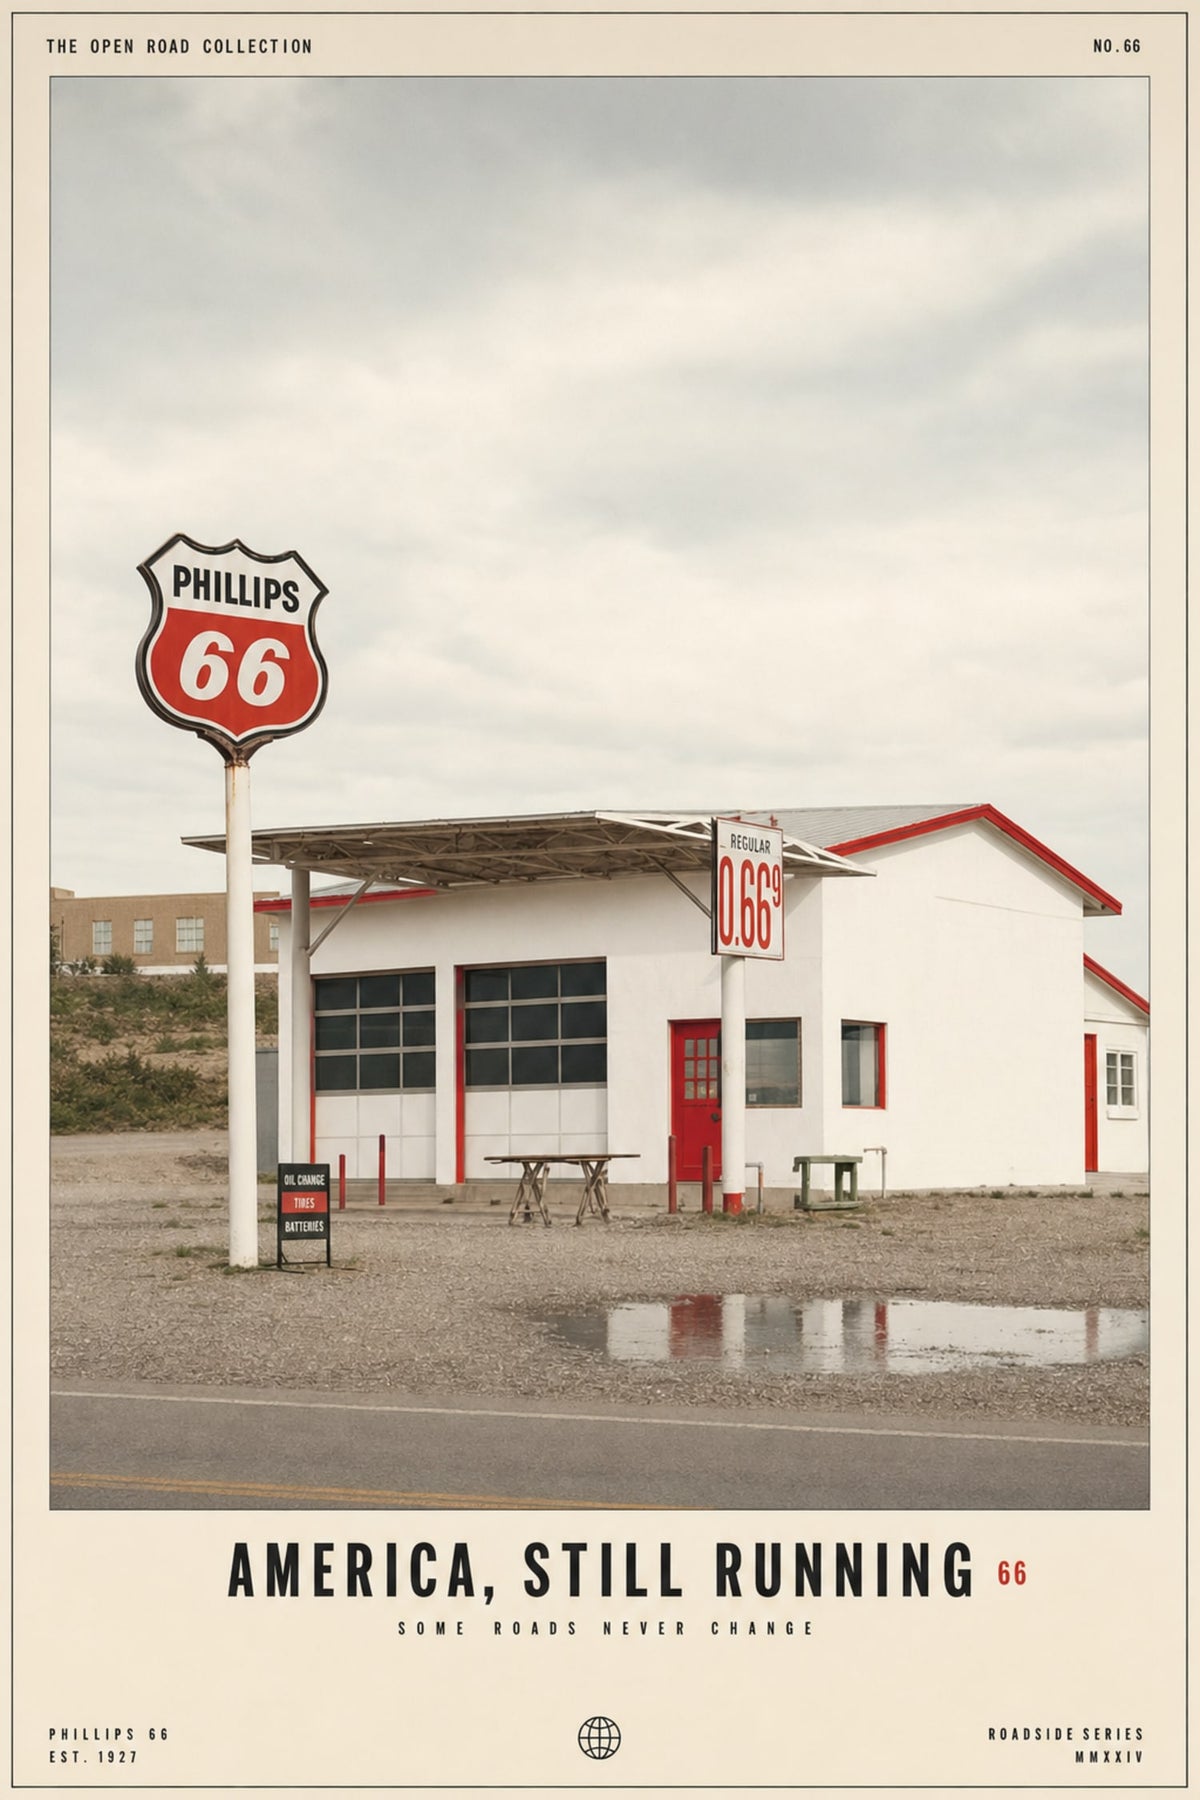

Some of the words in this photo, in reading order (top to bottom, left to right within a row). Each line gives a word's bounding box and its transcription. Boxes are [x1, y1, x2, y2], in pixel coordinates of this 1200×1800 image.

[173, 564, 300, 613] PHILLIPS
[179, 630, 290, 707] 66
[730, 833, 771, 854] REGULAR
[284, 1174, 296, 1186] OIL
[297, 1174, 325, 1186] CHANGE
